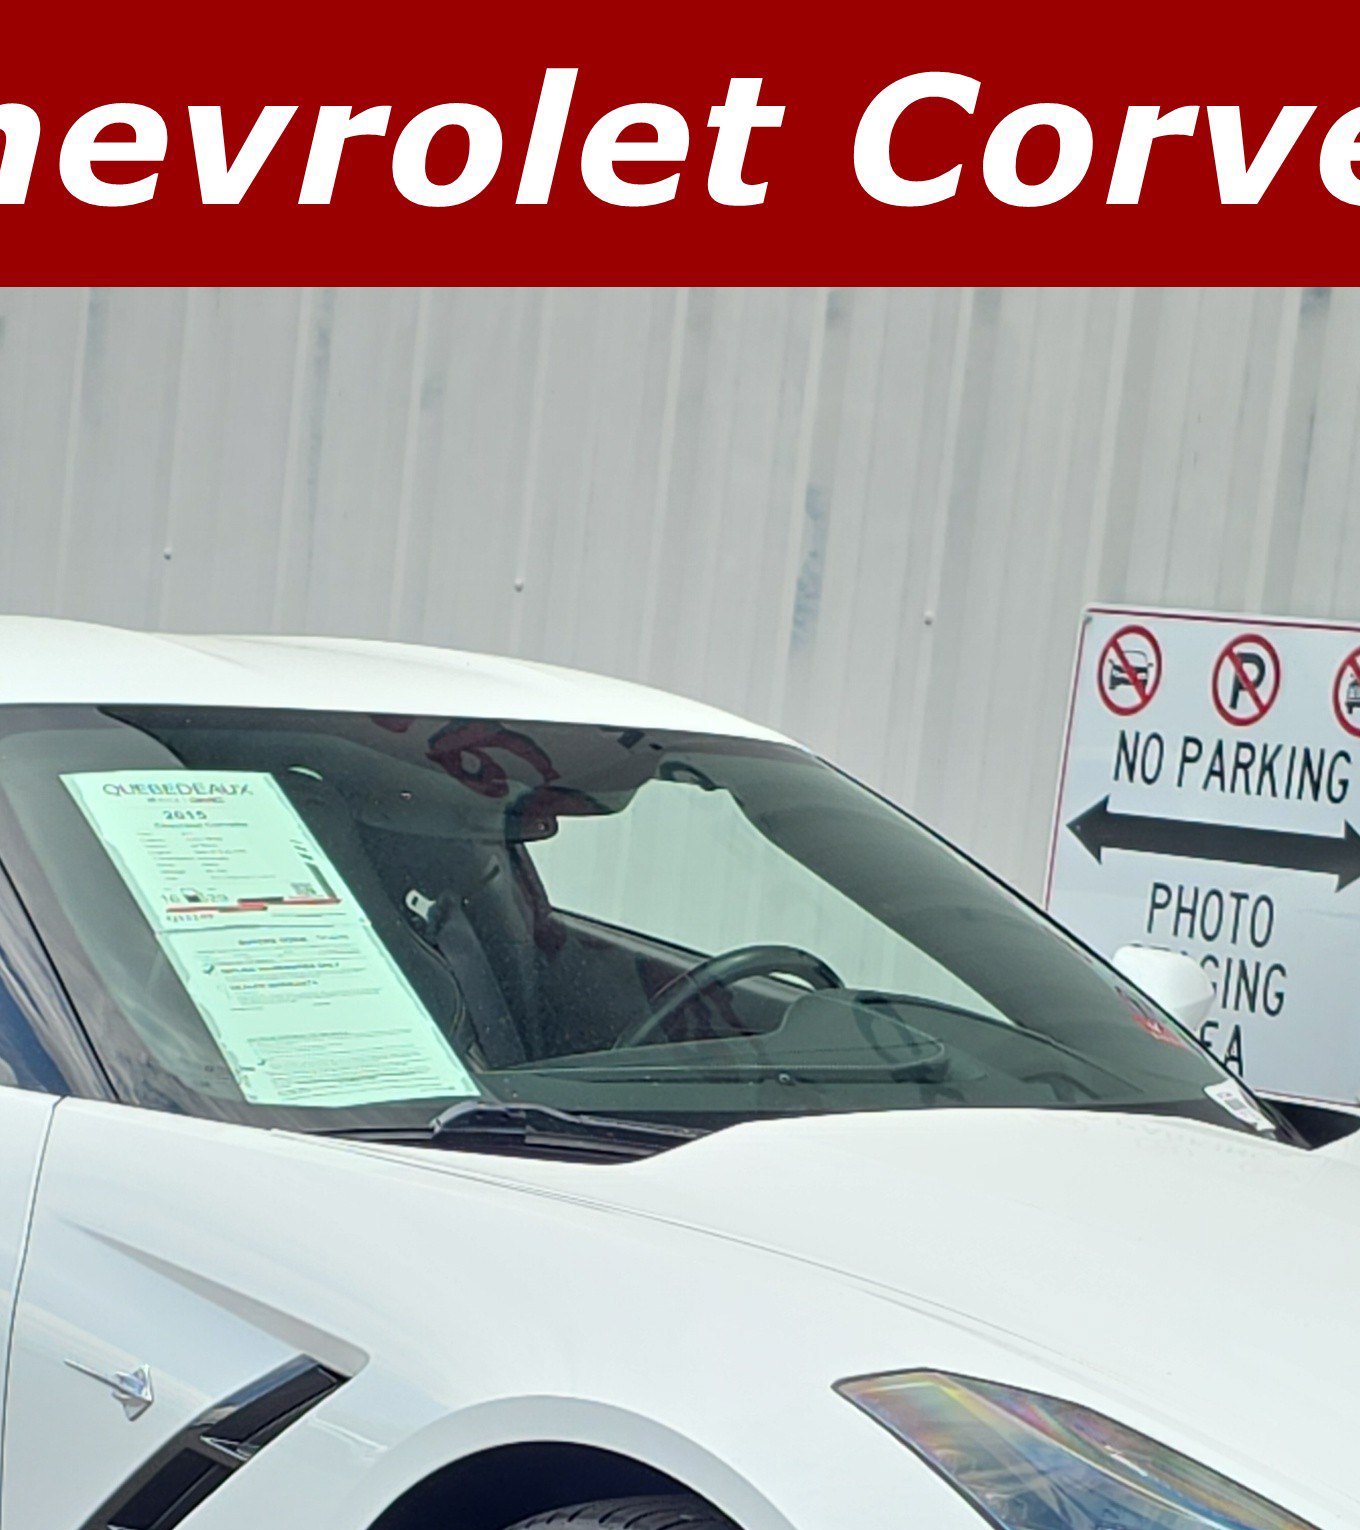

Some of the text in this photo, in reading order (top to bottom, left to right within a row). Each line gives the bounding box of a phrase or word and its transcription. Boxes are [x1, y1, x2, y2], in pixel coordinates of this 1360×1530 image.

[1113, 730, 1353, 804] NO PARKING
[102, 782, 255, 797] QUEBEDEAUX
[162, 810, 208, 820] 2015
[1146, 882, 1276, 949] PHOTO
